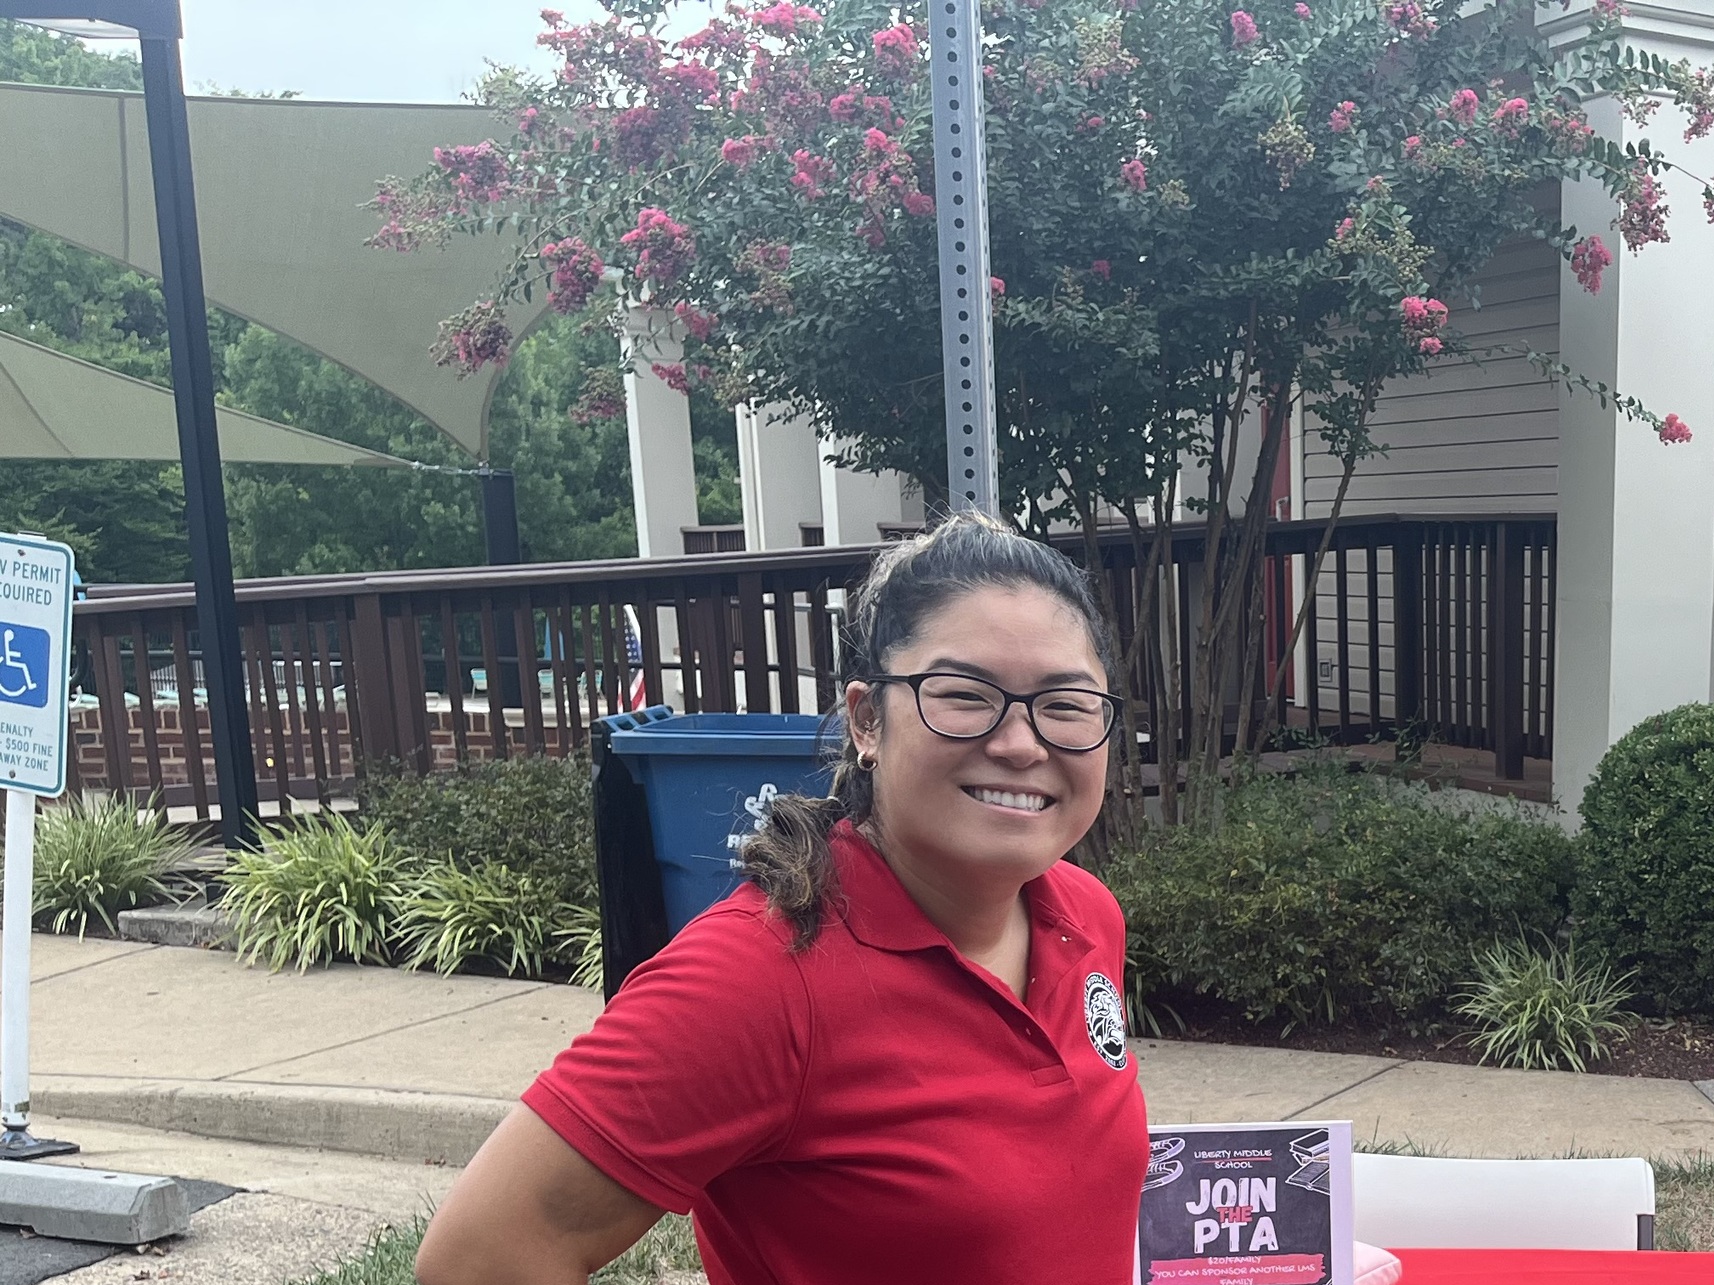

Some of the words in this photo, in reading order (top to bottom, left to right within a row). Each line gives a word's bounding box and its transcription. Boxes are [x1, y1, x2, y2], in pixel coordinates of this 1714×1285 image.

[13, 561, 62, 585] PERMIT
[0, 582, 52, 606] QUIRED
[33, 743, 53, 757] FINE
[25, 757, 49, 772] ZONE
[1194, 1150, 1231, 1159] LIBERTY
[1233, 1149, 1273, 1158] MIDDLE
[1214, 1161, 1253, 1170] SCHOOL
[1185, 1177, 1276, 1215] JOIN
[1217, 1205, 1253, 1223] THE
[1194, 1216, 1278, 1254] PTA
[1208, 1256, 1262, 1265] $20/FAMILY
[1155, 1270, 1176, 1279] YOU
[1178, 1268, 1199, 1277] CAN
[1201, 1267, 1247, 1277] SPONSOR
[1249, 1265, 1295, 1275] ANOTHER
[1297, 1263, 1316, 1272] LMS
